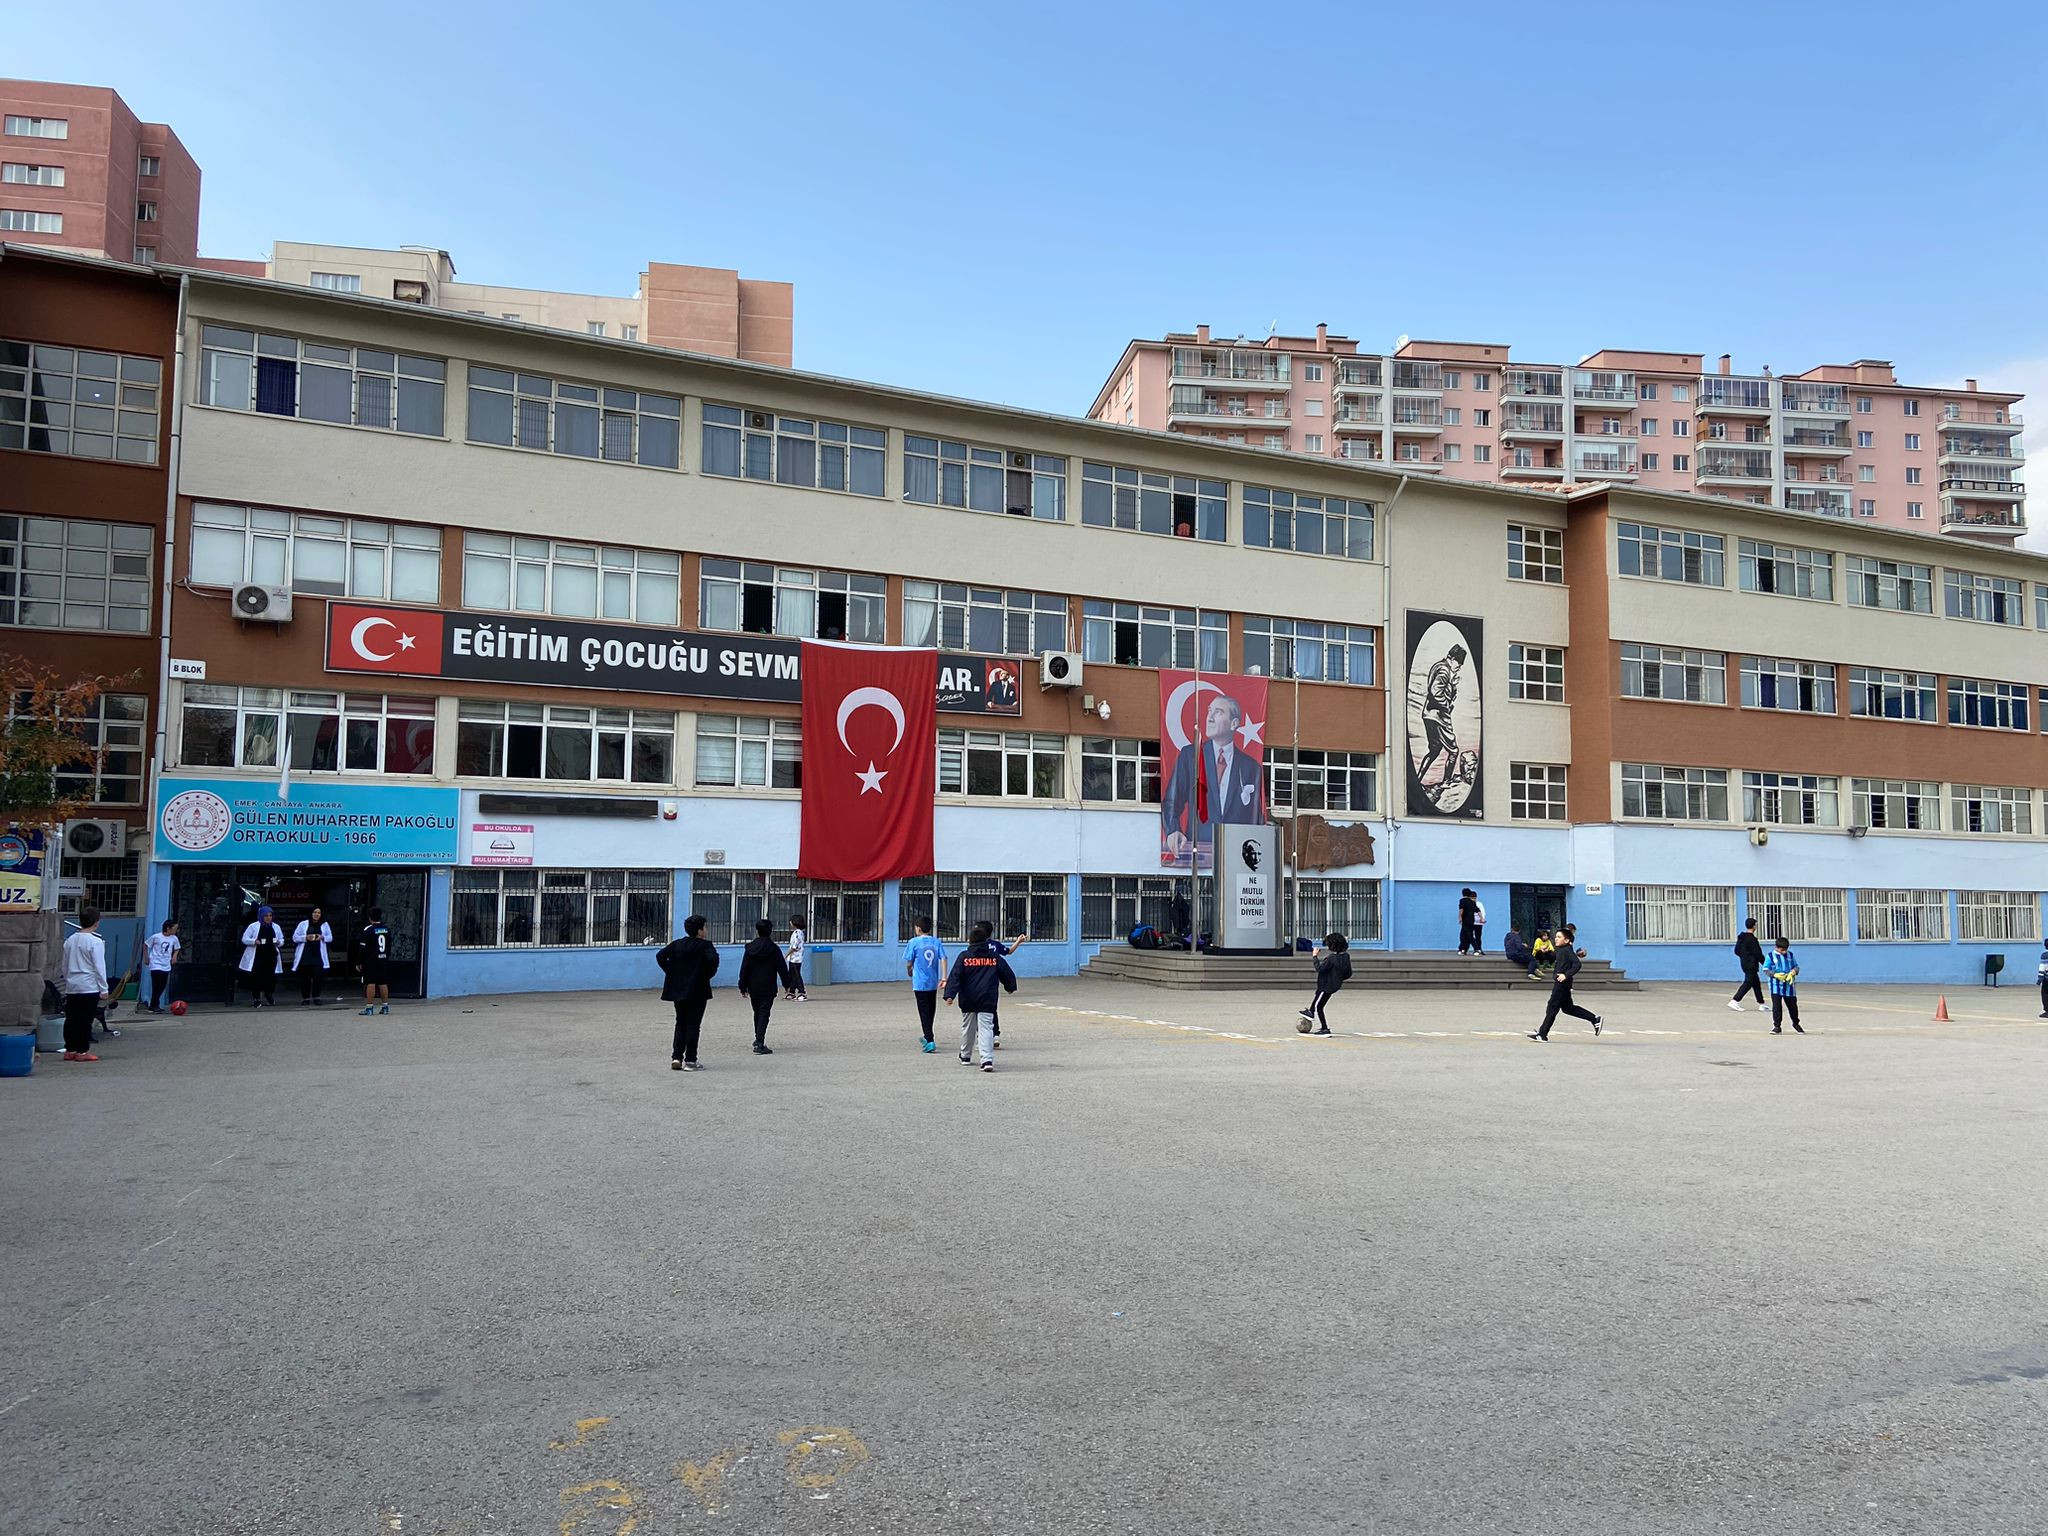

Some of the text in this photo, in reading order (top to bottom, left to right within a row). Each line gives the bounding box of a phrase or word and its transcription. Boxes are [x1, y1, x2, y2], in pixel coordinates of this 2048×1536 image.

[452, 623, 980, 693] EĞİTİM ÇOCUĞU SEVM AR.
[173, 664, 202, 674] B BLOK
[234, 809, 288, 825] GÜLEN
[293, 813, 380, 827] MUHARREM
[386, 814, 455, 829] PAKOĞLU
[233, 829, 330, 844] ORTAOKULU
[344, 832, 376, 844] 1966
[1248, 876, 1257, 885] NE
[1241, 887, 1263, 895] MUTLU
[1239, 896, 1265, 906] TÜRKÜM
[377, 934, 386, 953] 9
[924, 949, 935, 968] 9
